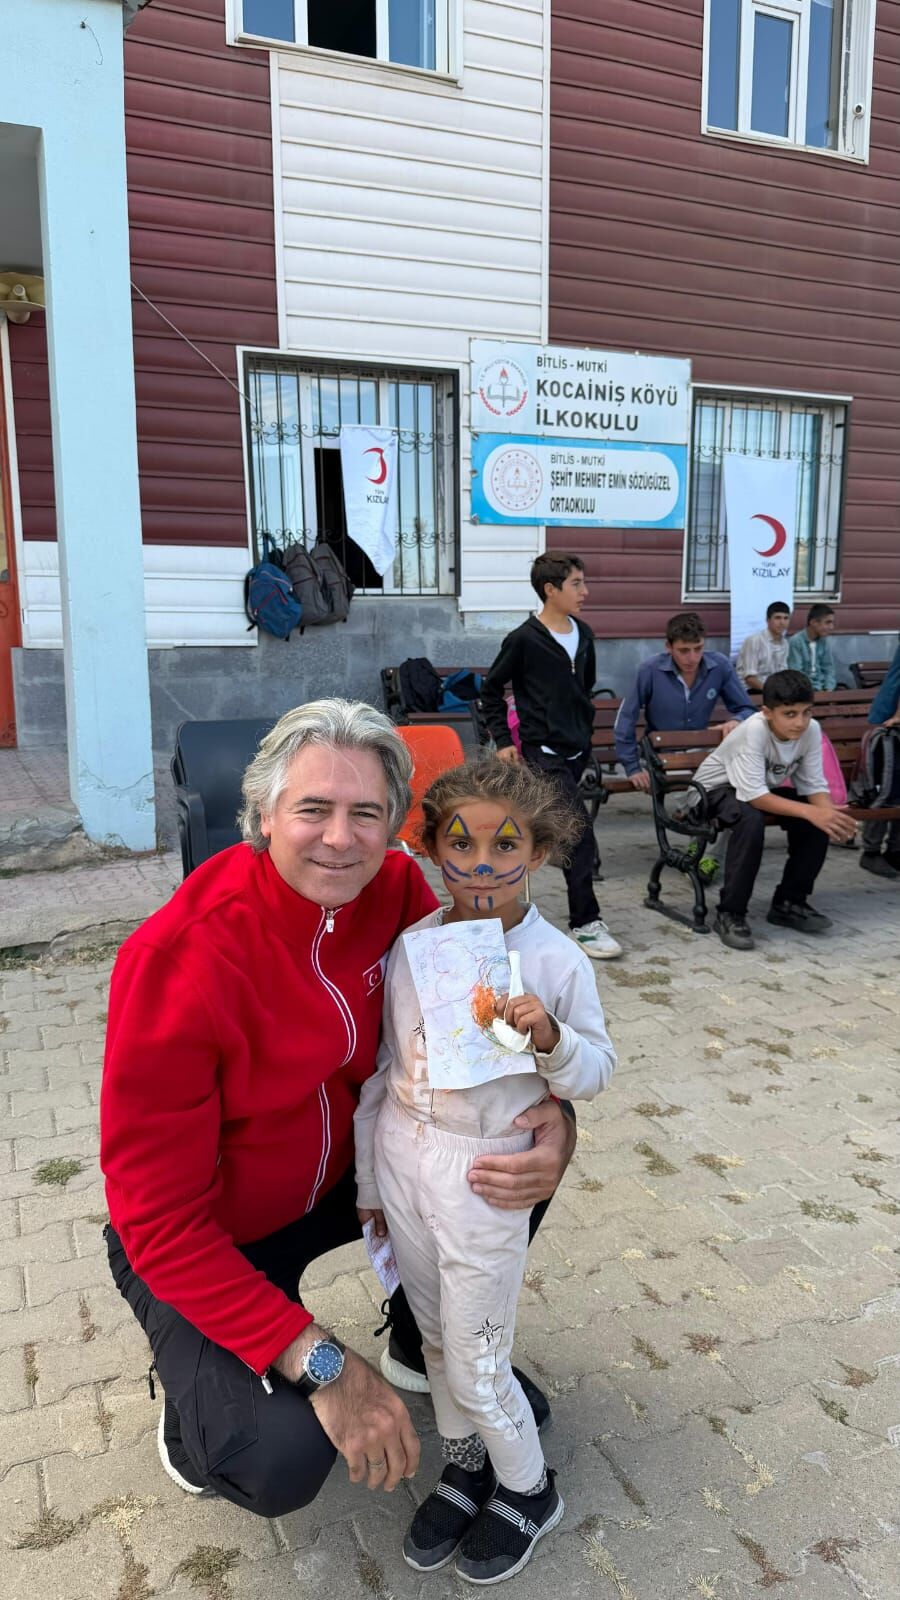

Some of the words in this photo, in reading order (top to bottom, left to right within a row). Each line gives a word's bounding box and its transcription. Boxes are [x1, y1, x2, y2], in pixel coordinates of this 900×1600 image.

[536, 353, 567, 370] BİTLİS
[577, 360, 607, 373] MUTKİ
[536, 378, 625, 407] KOCAİNİŞ
[631, 383, 677, 406] KÖYÜ
[536, 403, 638, 431] İLKOKULU
[551, 452, 574, 465] BİTLİS
[581, 454, 606, 466] MUTKİ
[551, 467, 573, 490] ŞEHİT
[575, 472, 606, 489] MEHMET
[608, 470, 627, 489] EMİN
[550, 497, 595, 513] ORTAOKULU
[752, 567, 790, 578] KIZILAY
